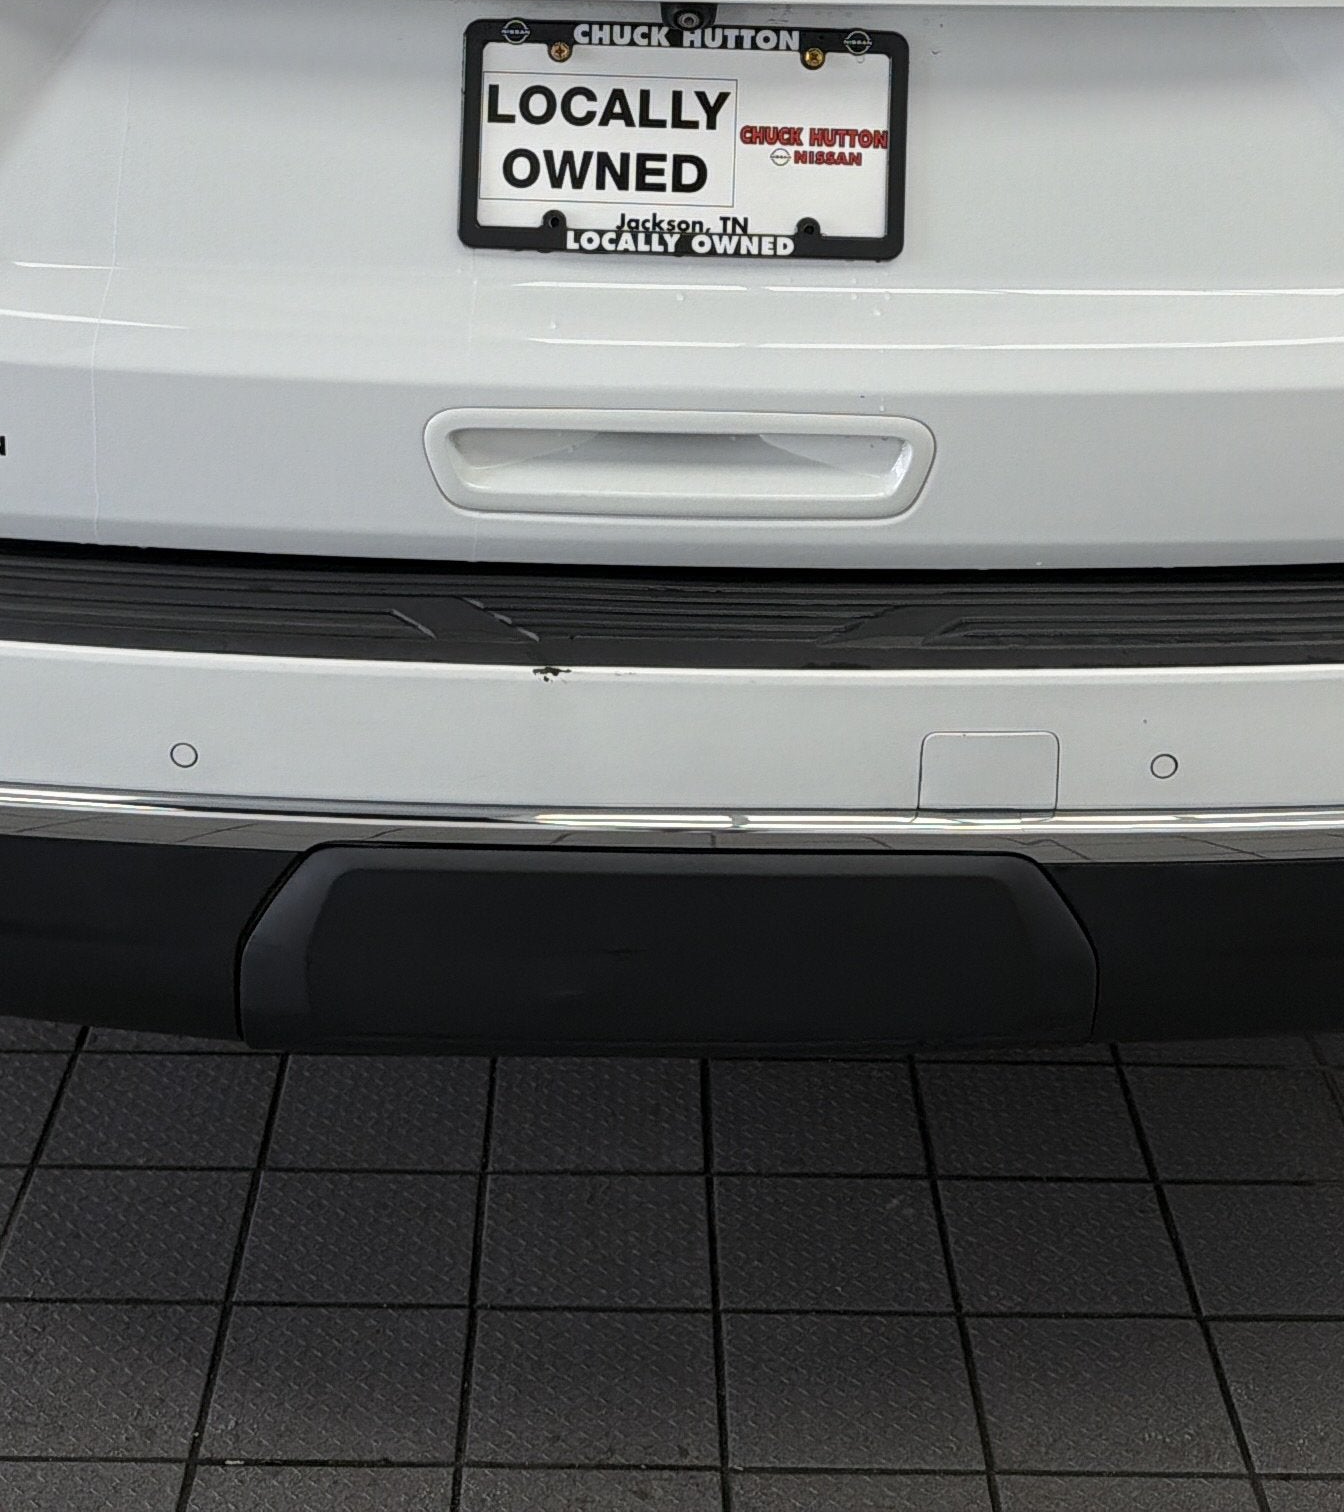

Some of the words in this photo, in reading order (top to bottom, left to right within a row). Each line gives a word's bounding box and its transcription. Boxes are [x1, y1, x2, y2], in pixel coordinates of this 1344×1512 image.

[573, 23, 671, 47] CHUCK
[682, 27, 800, 51] HUTTON
[487, 84, 731, 131] LOCALLY
[740, 125, 804, 147] CHUCK
[809, 128, 889, 149] HUTTON
[502, 147, 708, 194] OWNED
[794, 150, 863, 166] NISSAN
[616, 213, 711, 234] Jackson,
[719, 216, 749, 234] TN
[566, 230, 681, 252] LOCALLY
[691, 234, 795, 256] OWNED
